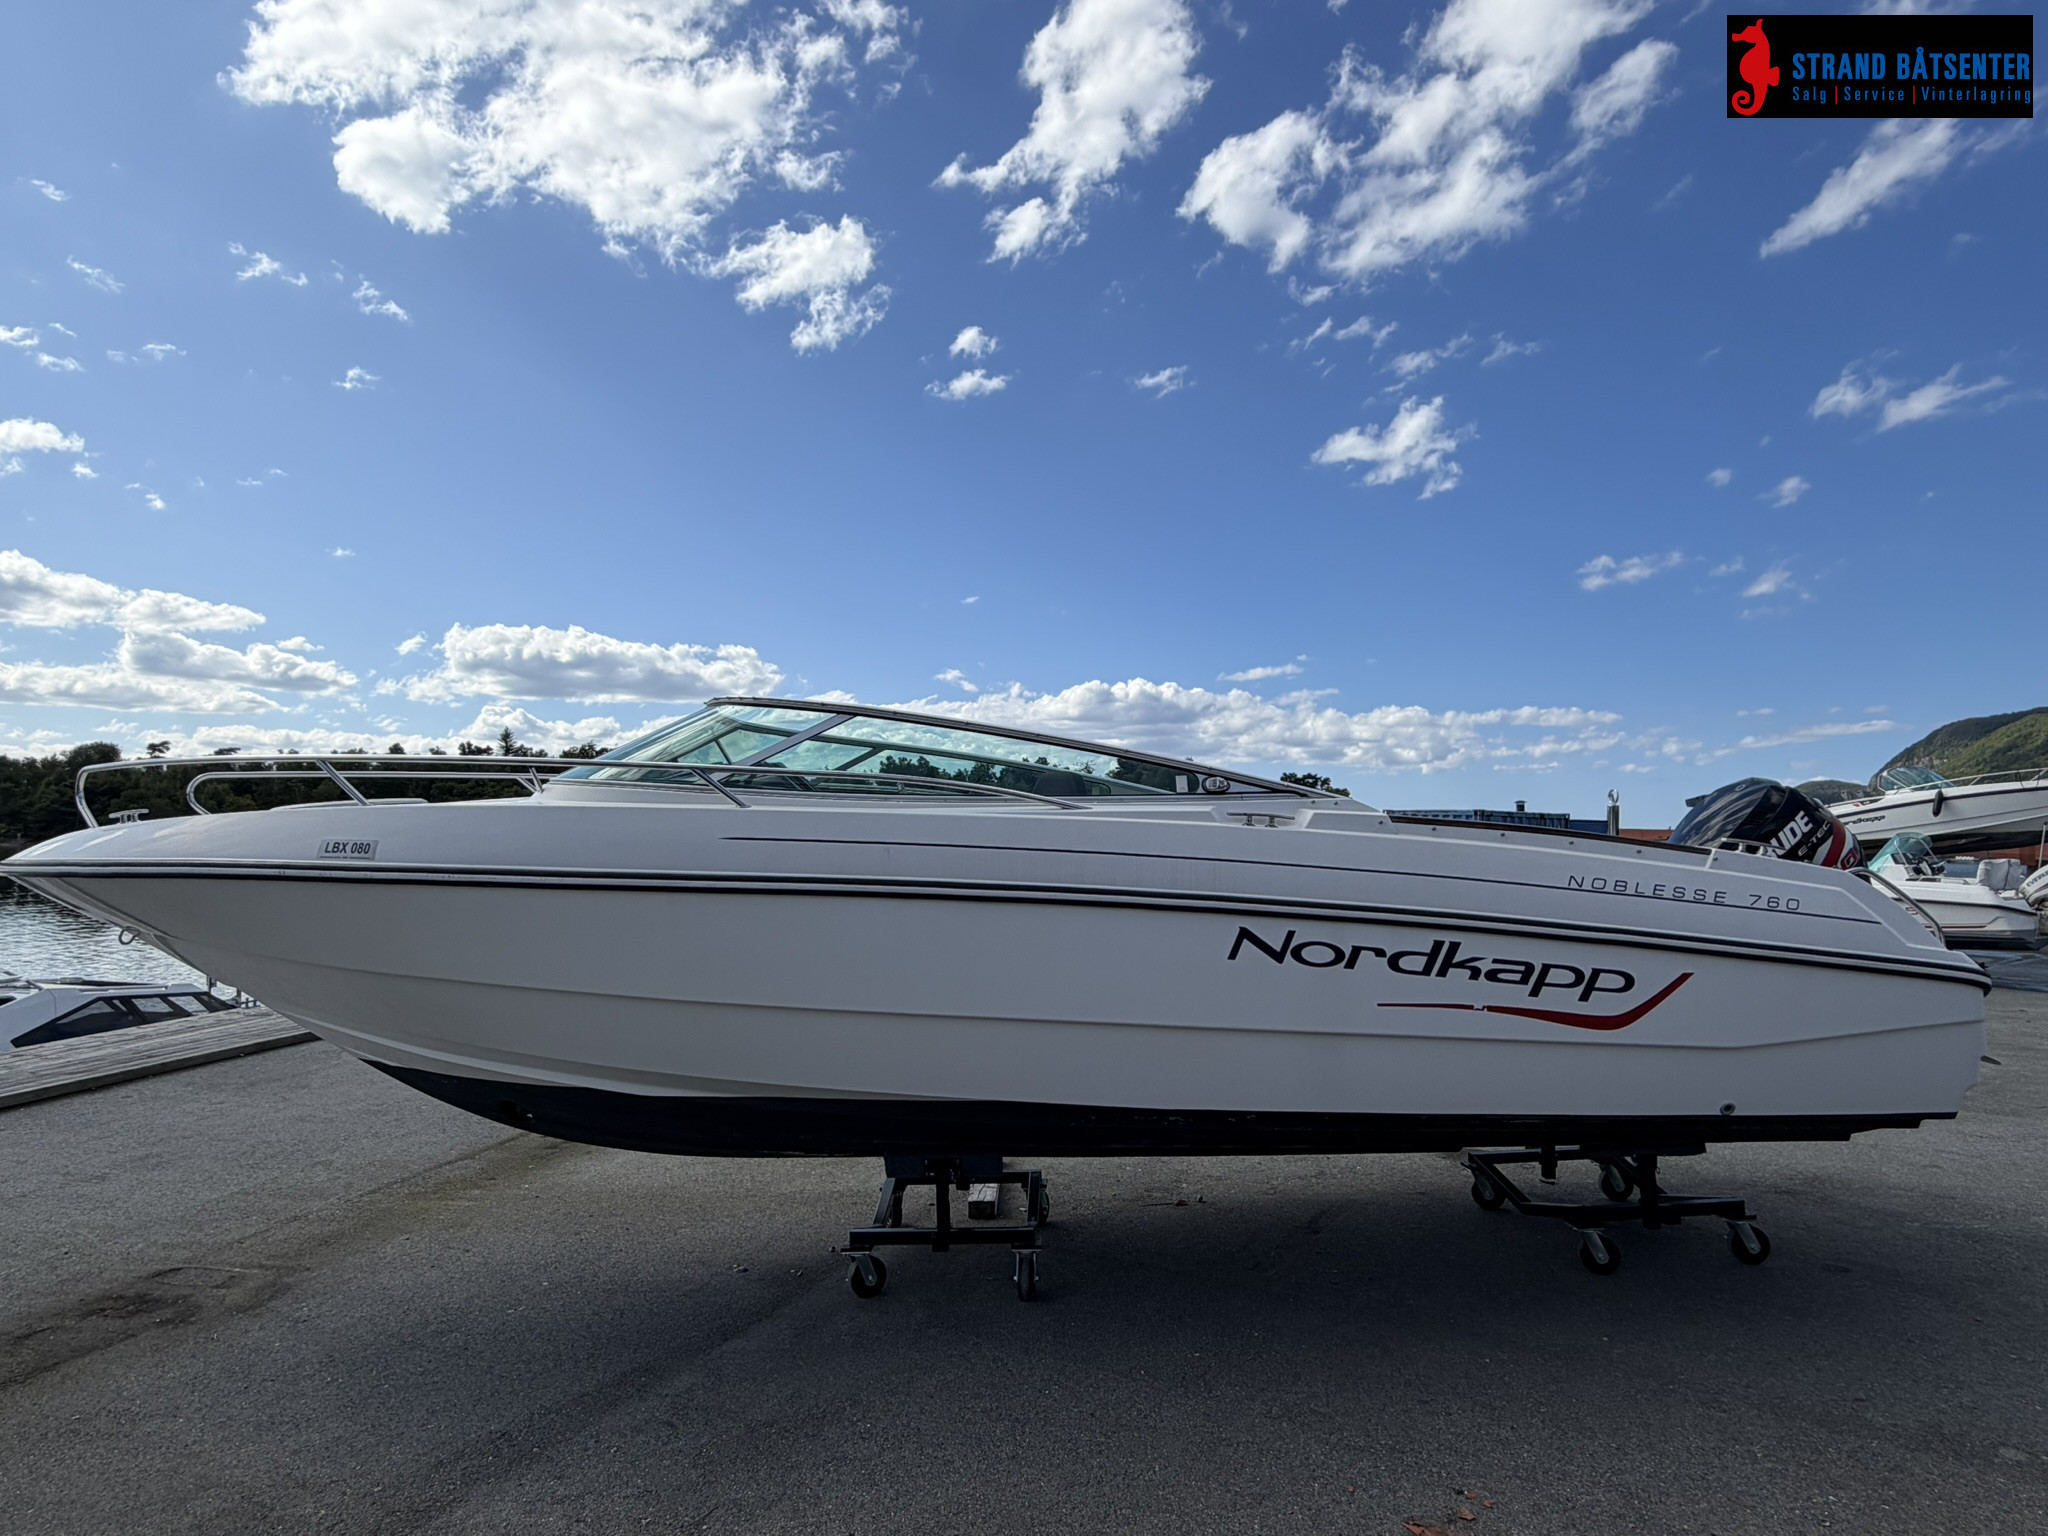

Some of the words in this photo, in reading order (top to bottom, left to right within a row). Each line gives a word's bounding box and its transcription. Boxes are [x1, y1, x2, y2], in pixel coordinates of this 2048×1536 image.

[324, 841, 350, 854] LBX
[350, 841, 372, 855] 080
[1567, 874, 1728, 904] NOBLESSE
[1748, 893, 1801, 912] 760
[1226, 925, 1637, 1003] Nordkapp
